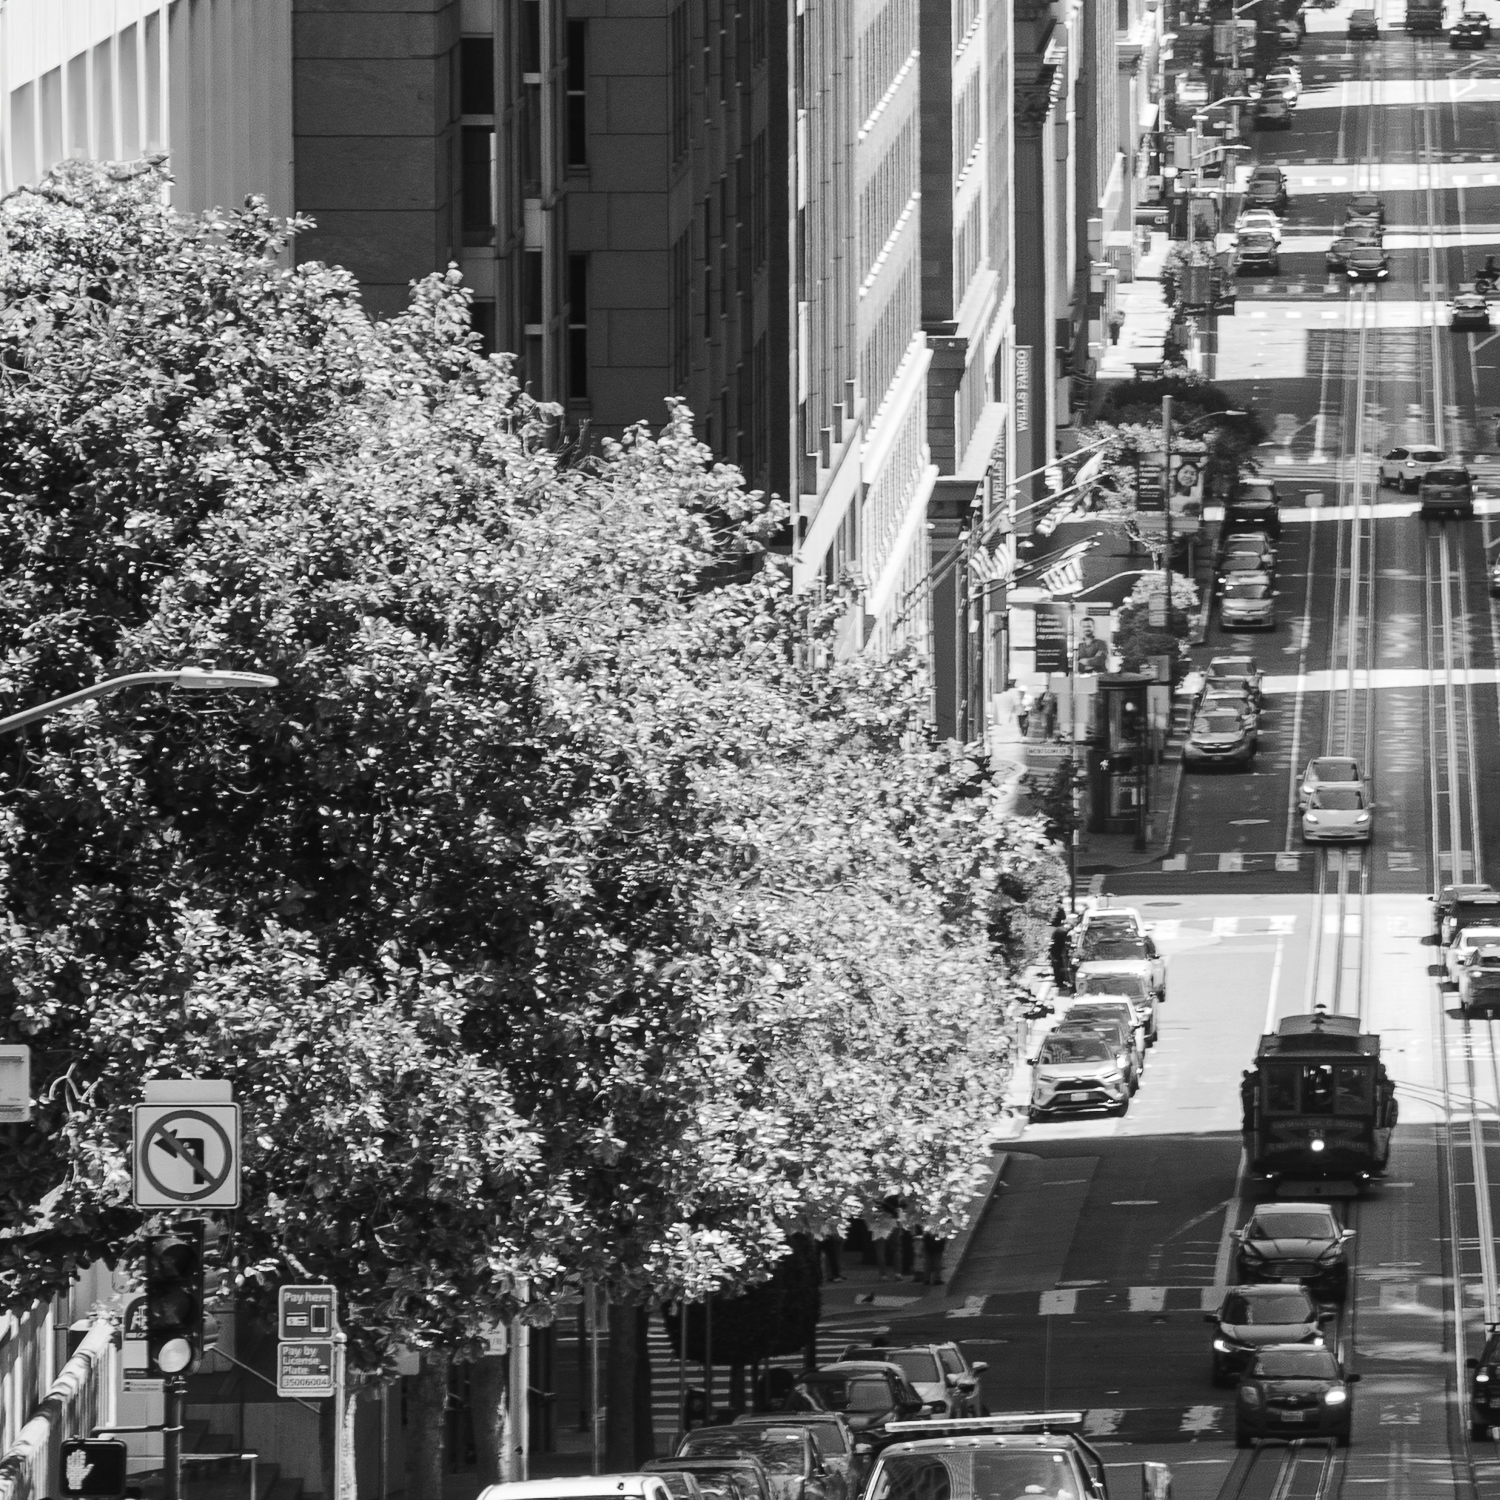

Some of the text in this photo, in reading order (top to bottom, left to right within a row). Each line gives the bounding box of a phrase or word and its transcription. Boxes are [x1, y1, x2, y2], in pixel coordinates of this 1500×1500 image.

[1016, 349, 1029, 432] WELLS FARGO
[283, 1291, 331, 1305] Pay here
[282, 1345, 318, 1358] Pay by
[282, 1357, 321, 1366] License
[282, 1366, 311, 1375] Plate
